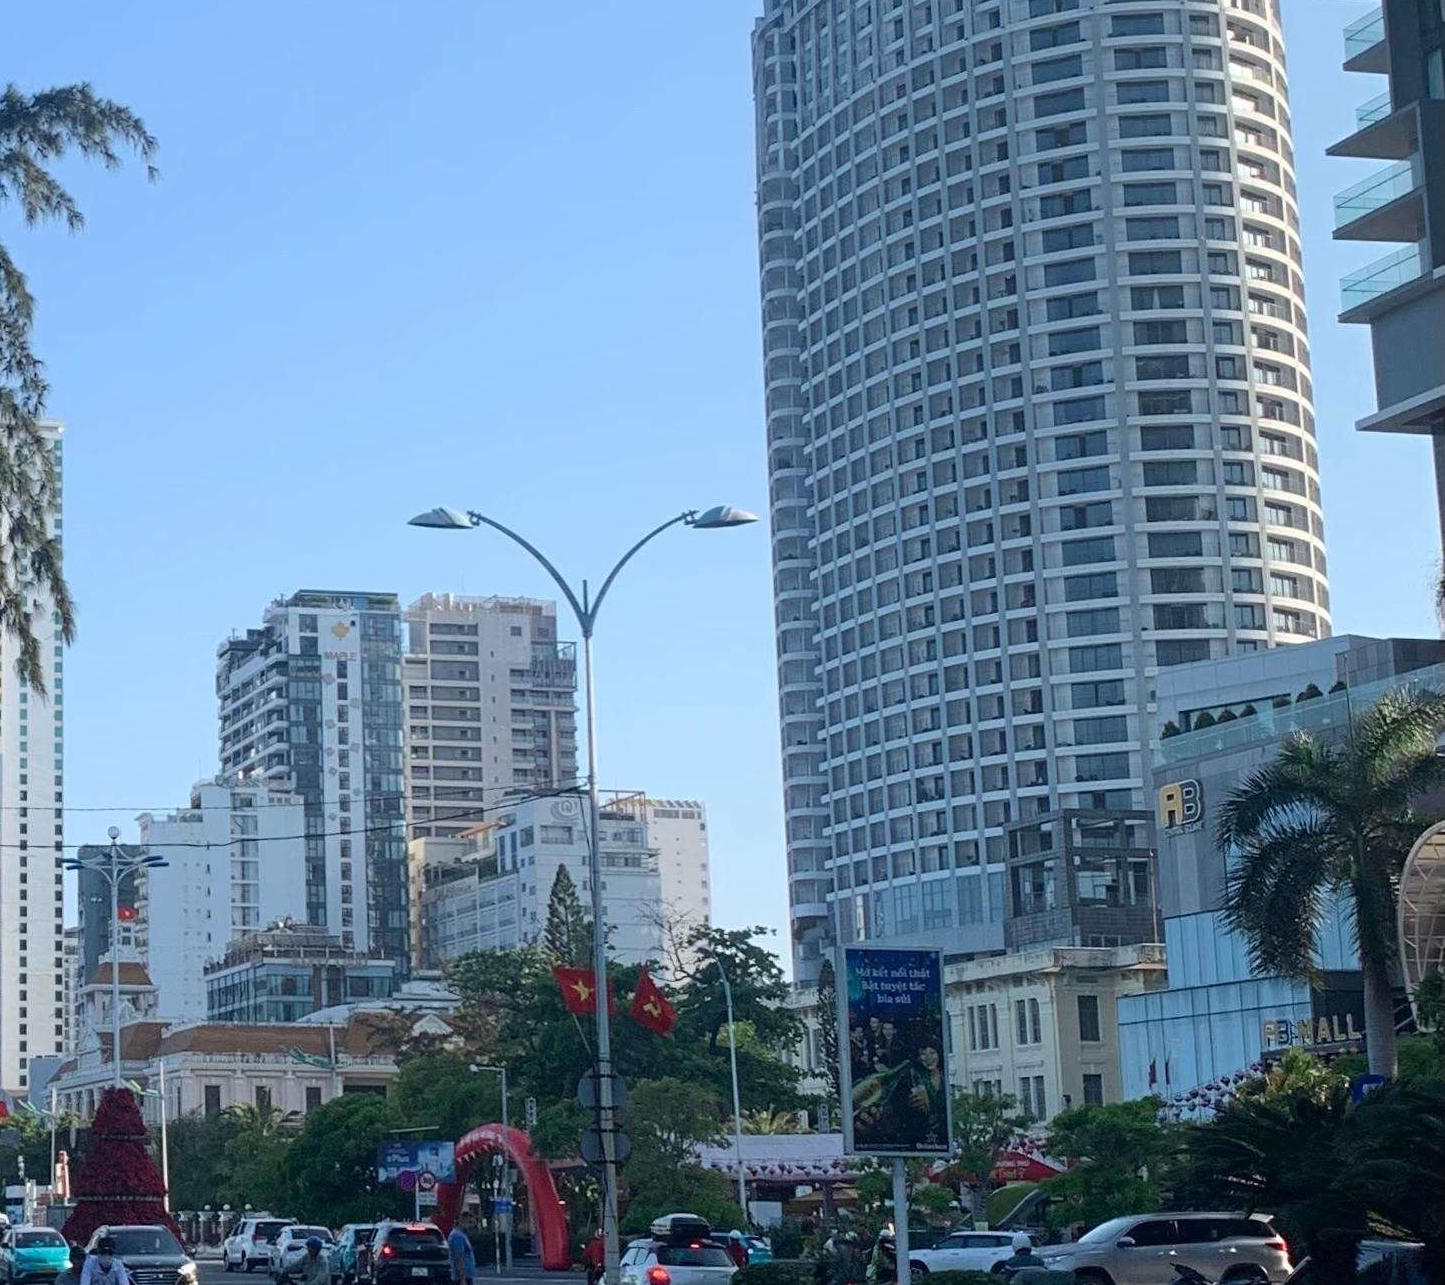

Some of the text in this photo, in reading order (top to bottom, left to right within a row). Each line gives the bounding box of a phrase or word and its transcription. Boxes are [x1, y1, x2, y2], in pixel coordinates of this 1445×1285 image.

[1159, 779, 1202, 828] AB
[877, 994, 893, 1003] bia
[1298, 1013, 1362, 1046] MALL
